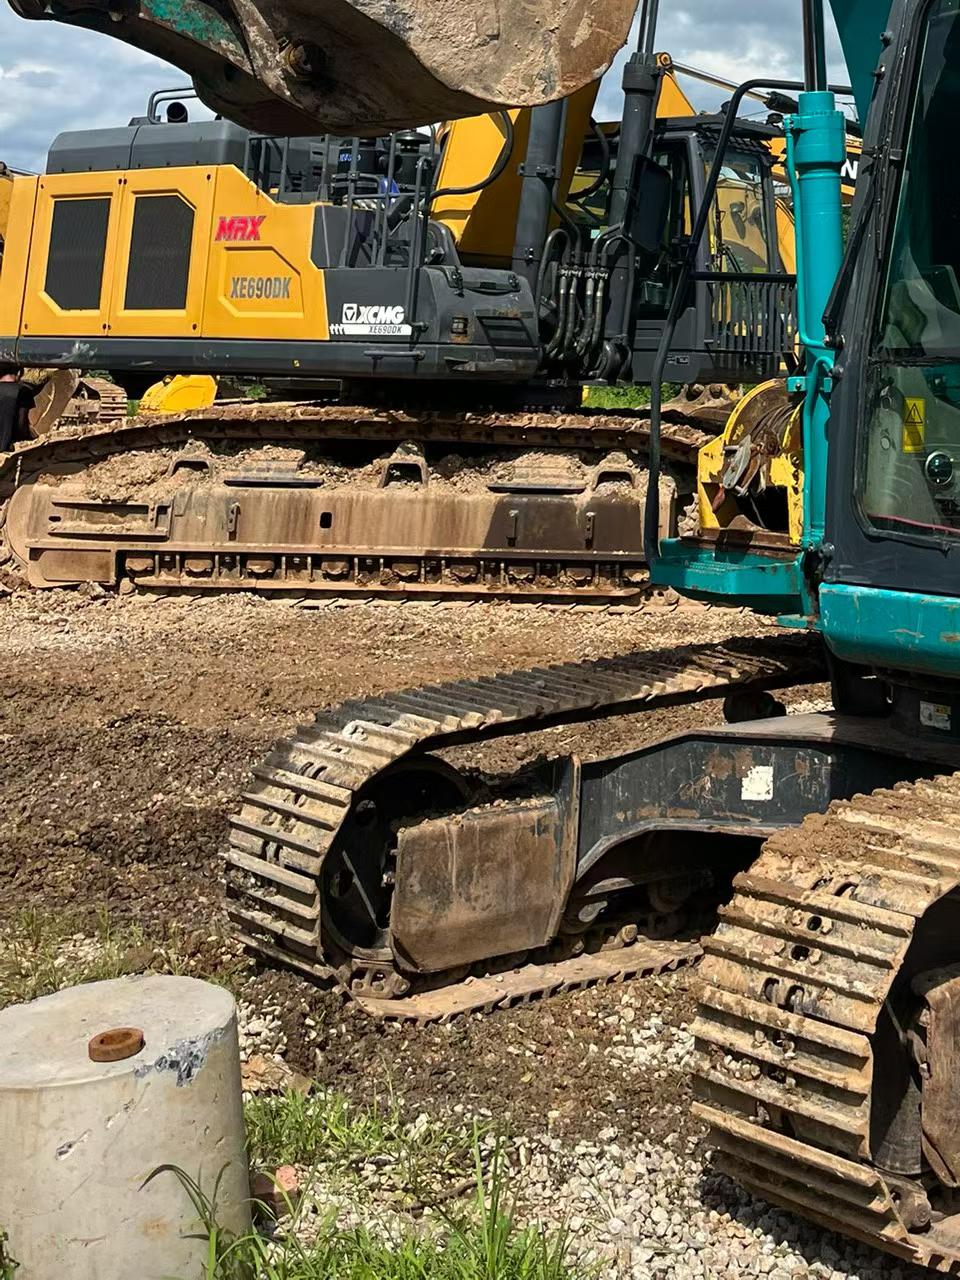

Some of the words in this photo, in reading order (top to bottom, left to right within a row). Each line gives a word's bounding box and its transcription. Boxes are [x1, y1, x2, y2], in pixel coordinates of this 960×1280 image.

[230, 276, 292, 300] XE690DK
[356, 305, 405, 324] XCMG
[368, 325, 403, 334] XE690DK
